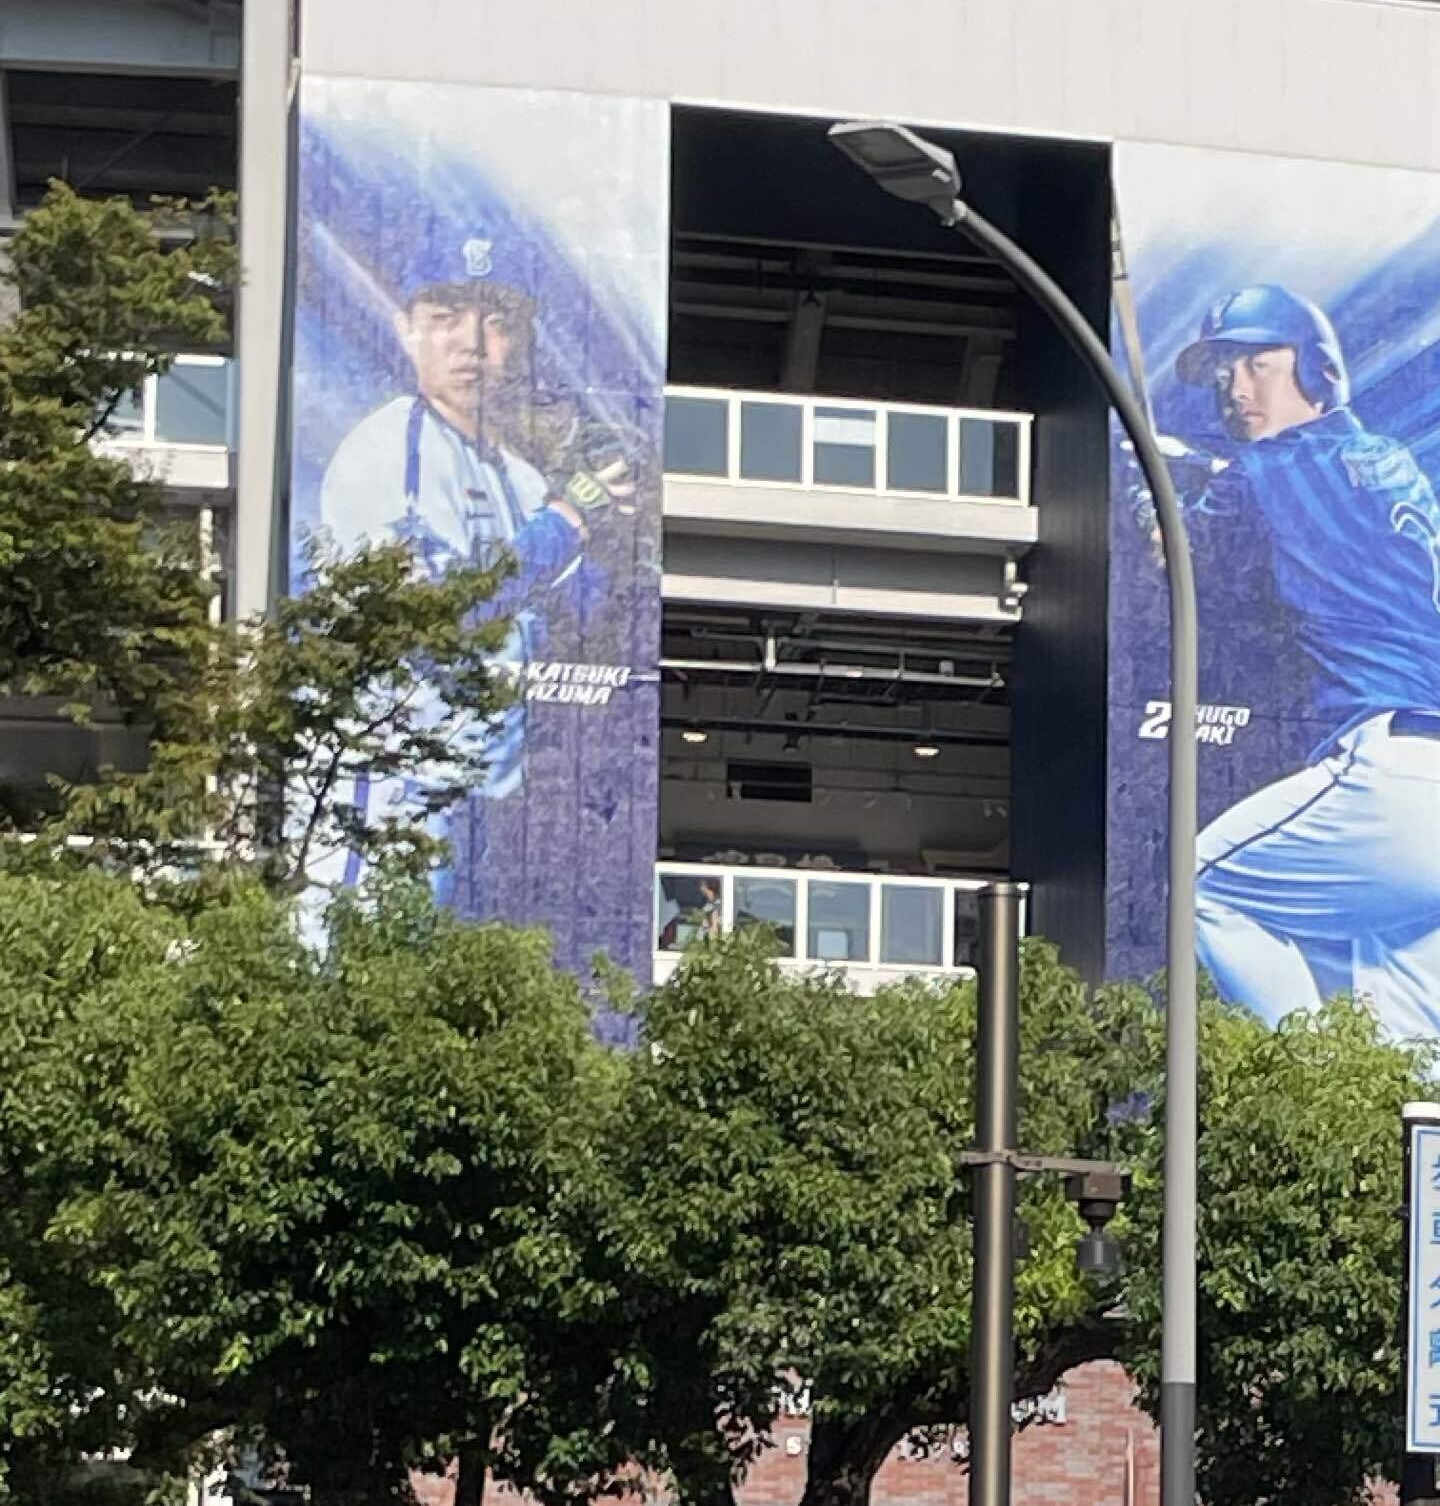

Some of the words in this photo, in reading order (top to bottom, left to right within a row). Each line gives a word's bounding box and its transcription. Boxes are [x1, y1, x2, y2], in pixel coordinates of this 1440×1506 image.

[527, 662, 632, 687] KATSUKI
[527, 683, 611, 705] AZUMA
[1194, 704, 1251, 727] HUGO
[1195, 725, 1235, 745] AKI
